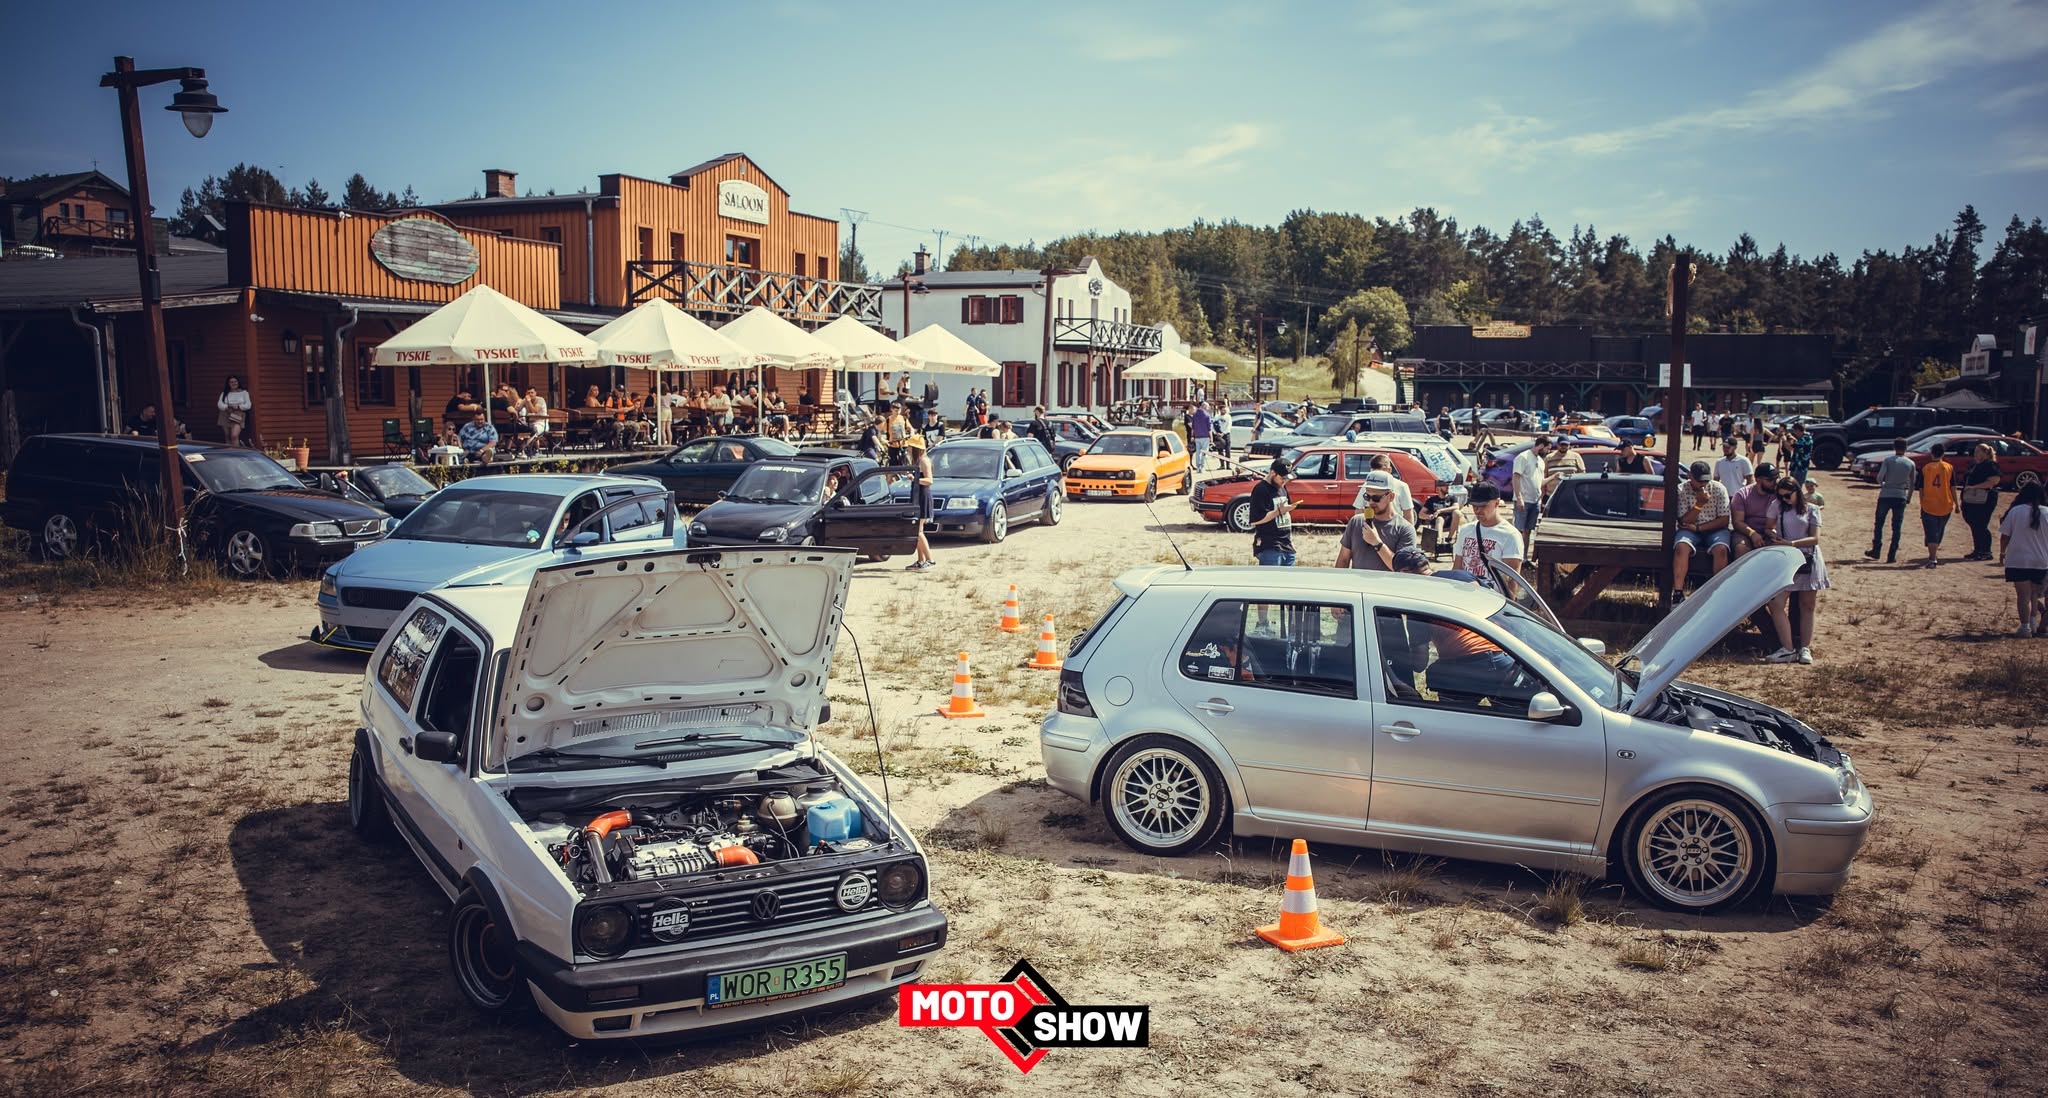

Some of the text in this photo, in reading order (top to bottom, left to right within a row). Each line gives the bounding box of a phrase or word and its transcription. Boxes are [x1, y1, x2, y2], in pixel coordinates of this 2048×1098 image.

[724, 191, 764, 212] SALOON
[395, 350, 432, 362] TYSKIE
[474, 347, 519, 360] TYSKIE
[558, 347, 586, 358] TYSKIE
[616, 354, 652, 364] TYSKIE
[690, 355, 721, 365] TYSKIE
[1932, 473, 1941, 488] 4
[842, 886, 868, 897] Hella
[652, 912, 689, 928] Hella
[723, 971, 772, 999] WOR
[783, 958, 841, 990] R355
